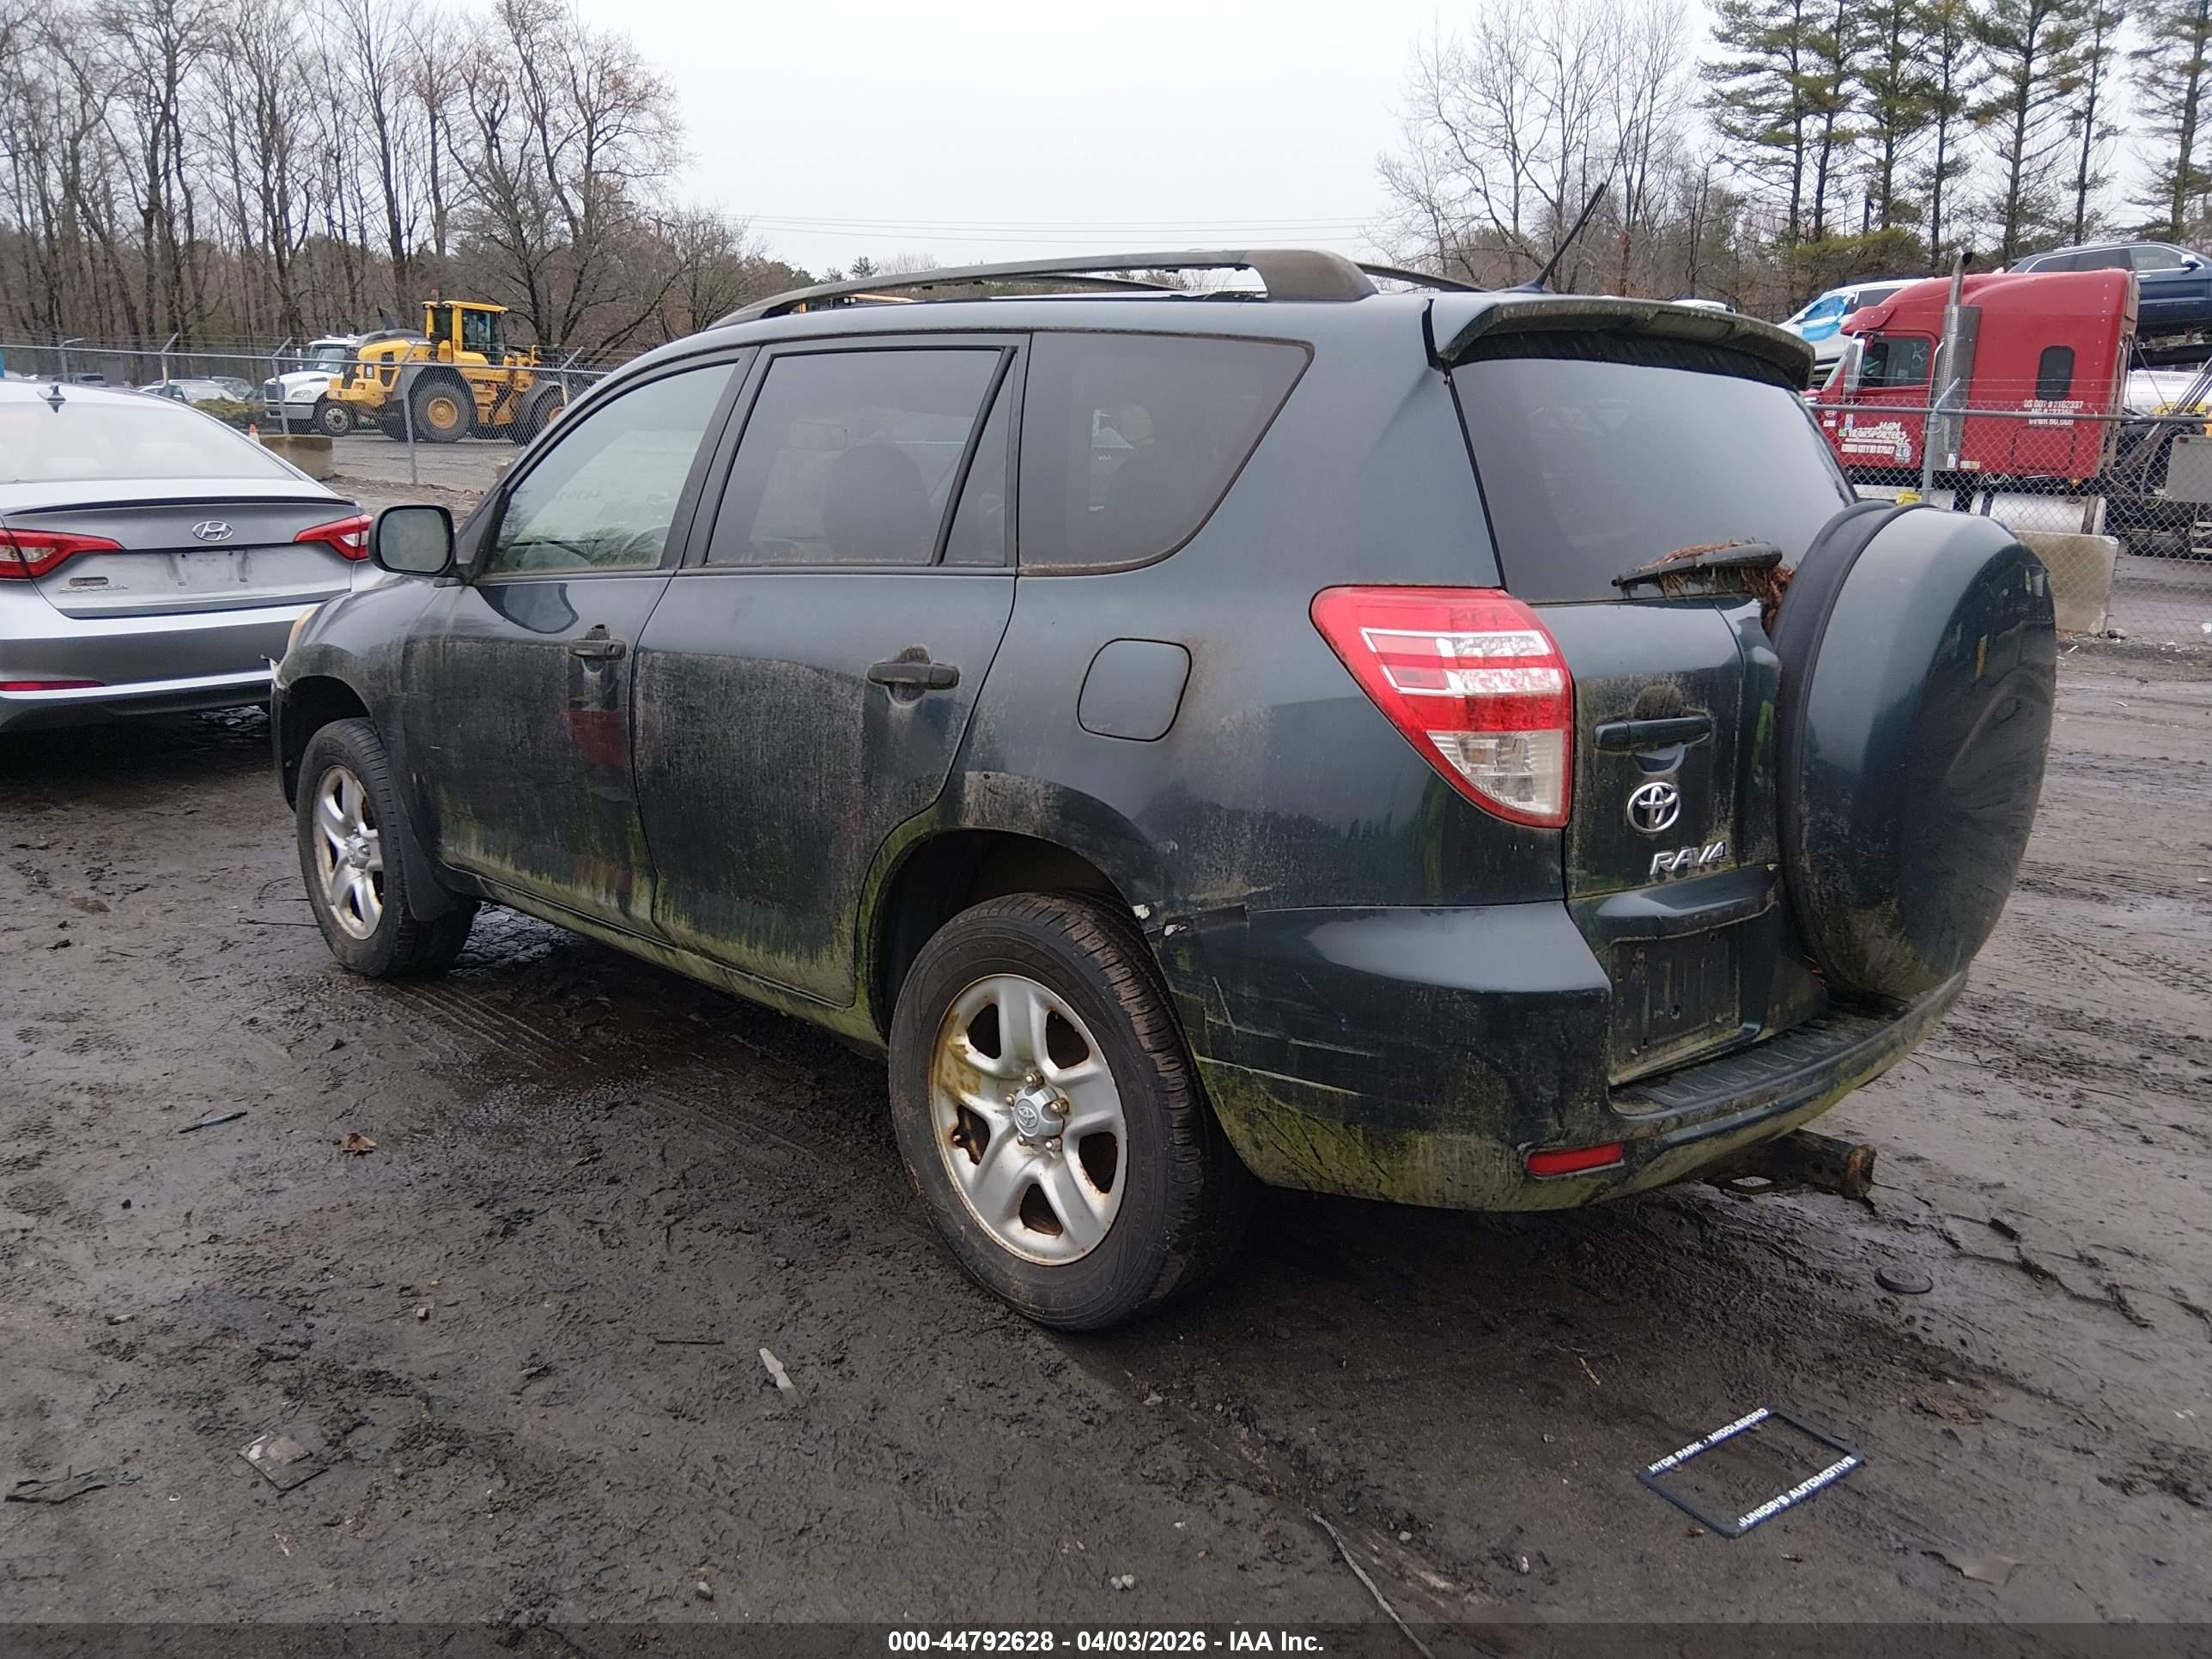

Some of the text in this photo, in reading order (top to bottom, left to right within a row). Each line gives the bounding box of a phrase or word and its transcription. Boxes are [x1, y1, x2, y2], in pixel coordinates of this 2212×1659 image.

[1650, 841, 1728, 876] RAV4
[1647, 1407, 1769, 1473] HYDE PARK MIDDLEBORO
[1738, 1455, 1856, 1527] JUNIOR'S AUTOMOTIVE
